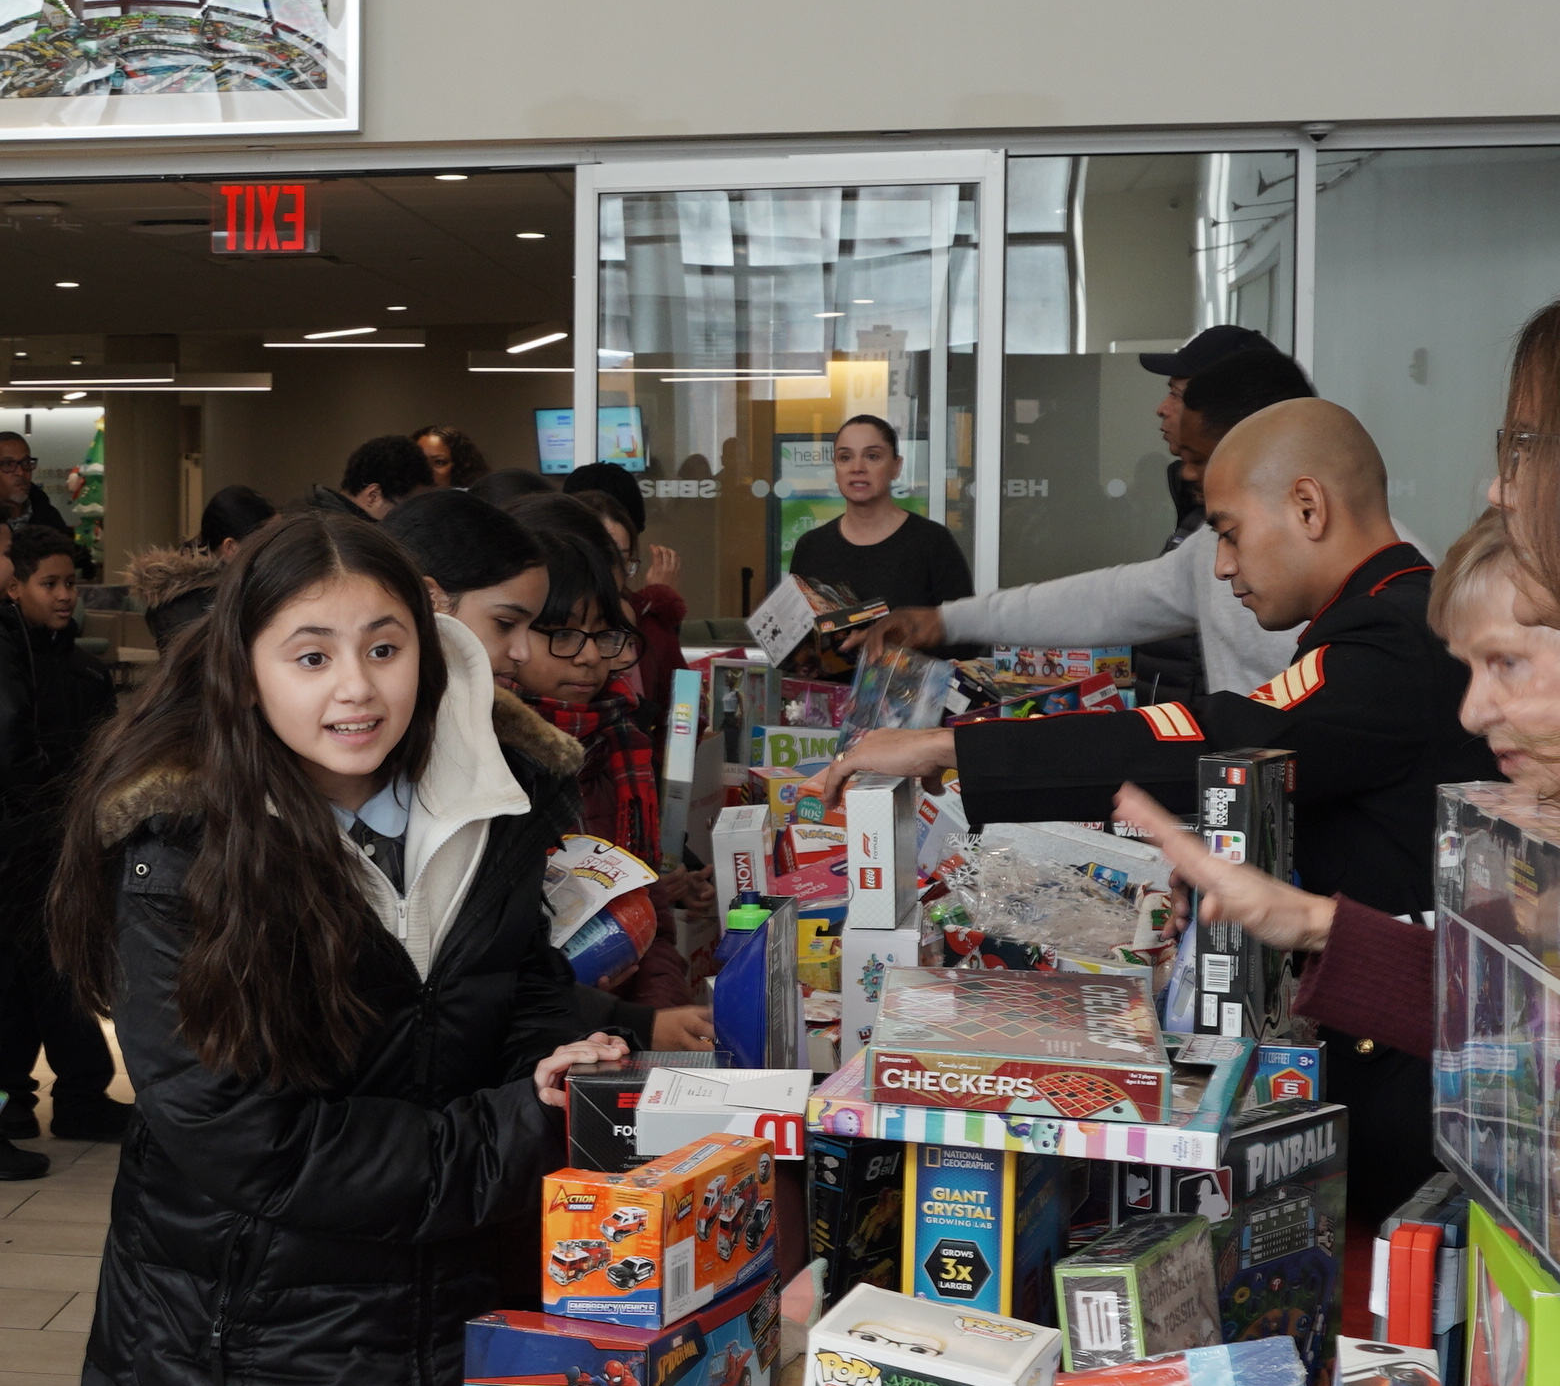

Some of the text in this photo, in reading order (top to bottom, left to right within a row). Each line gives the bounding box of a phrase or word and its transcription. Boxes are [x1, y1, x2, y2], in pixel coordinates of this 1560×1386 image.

[801, 808, 821, 821] 500
[575, 855, 629, 882] SPIDEY
[1299, 1056, 1314, 1066] 3+
[882, 1068, 1035, 1098] CHECKERS
[1283, 1083, 1299, 1093] 6
[944, 1150, 984, 1162] NATIONAL
[1246, 1121, 1337, 1196] PINBALL
[943, 1159, 995, 1172] GEOGRAPHIC
[549, 1185, 596, 1212] ACTION
[932, 1187, 988, 1204] GIANT
[922, 1201, 995, 1221] CRYSTAL
[925, 1216, 993, 1230] GROWING LAB
[941, 1248, 974, 1259] GROWS
[940, 1258, 973, 1282] 3x
[939, 1281, 972, 1292] LARGER
[569, 1302, 656, 1313] EMERGENCY VEHICLE
[959, 1316, 1036, 1339] POP!
